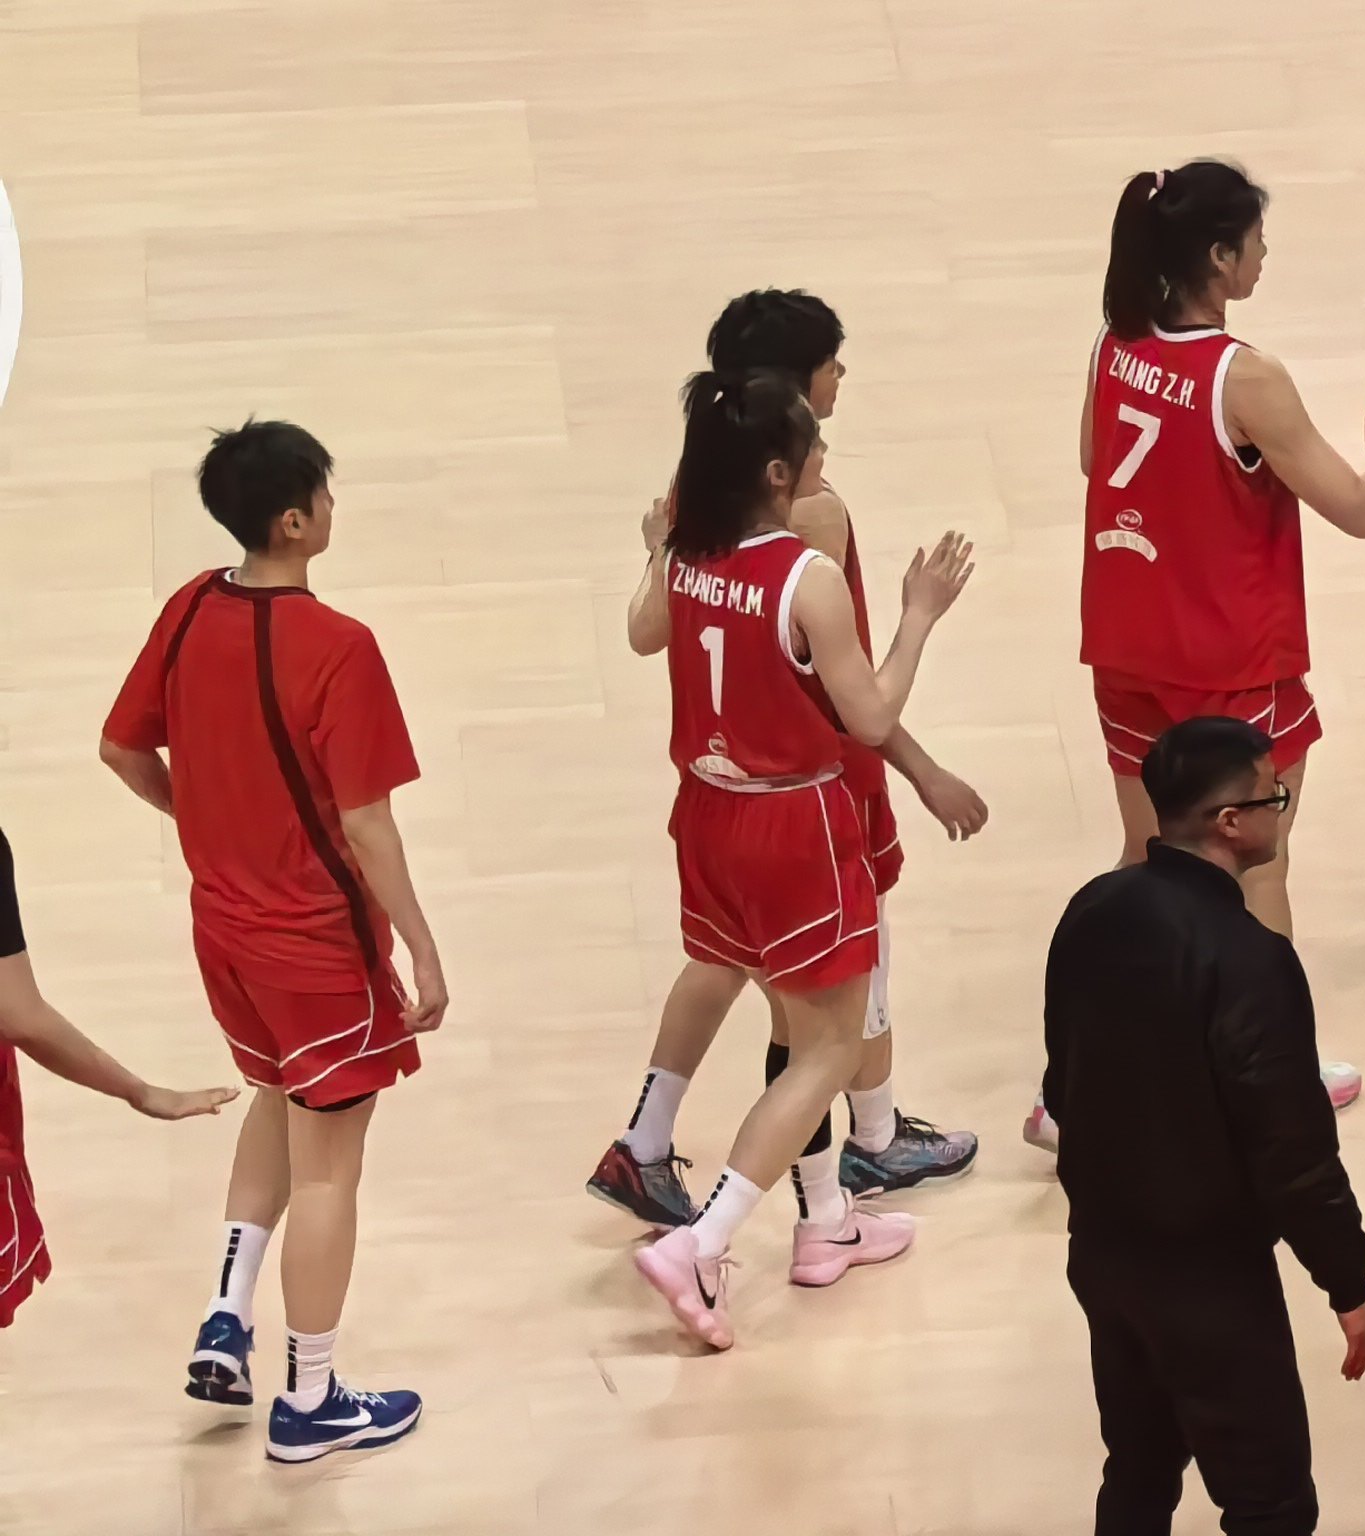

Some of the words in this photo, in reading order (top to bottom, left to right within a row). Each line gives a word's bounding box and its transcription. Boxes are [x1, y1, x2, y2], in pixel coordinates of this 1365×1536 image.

[1108, 346, 1163, 395] ZHANG
[1161, 372, 1196, 410] Z.H.
[1107, 402, 1162, 489] 7
[672, 562, 726, 607] ZHANG
[726, 579, 766, 619] M.M.
[699, 625, 725, 717] 1
